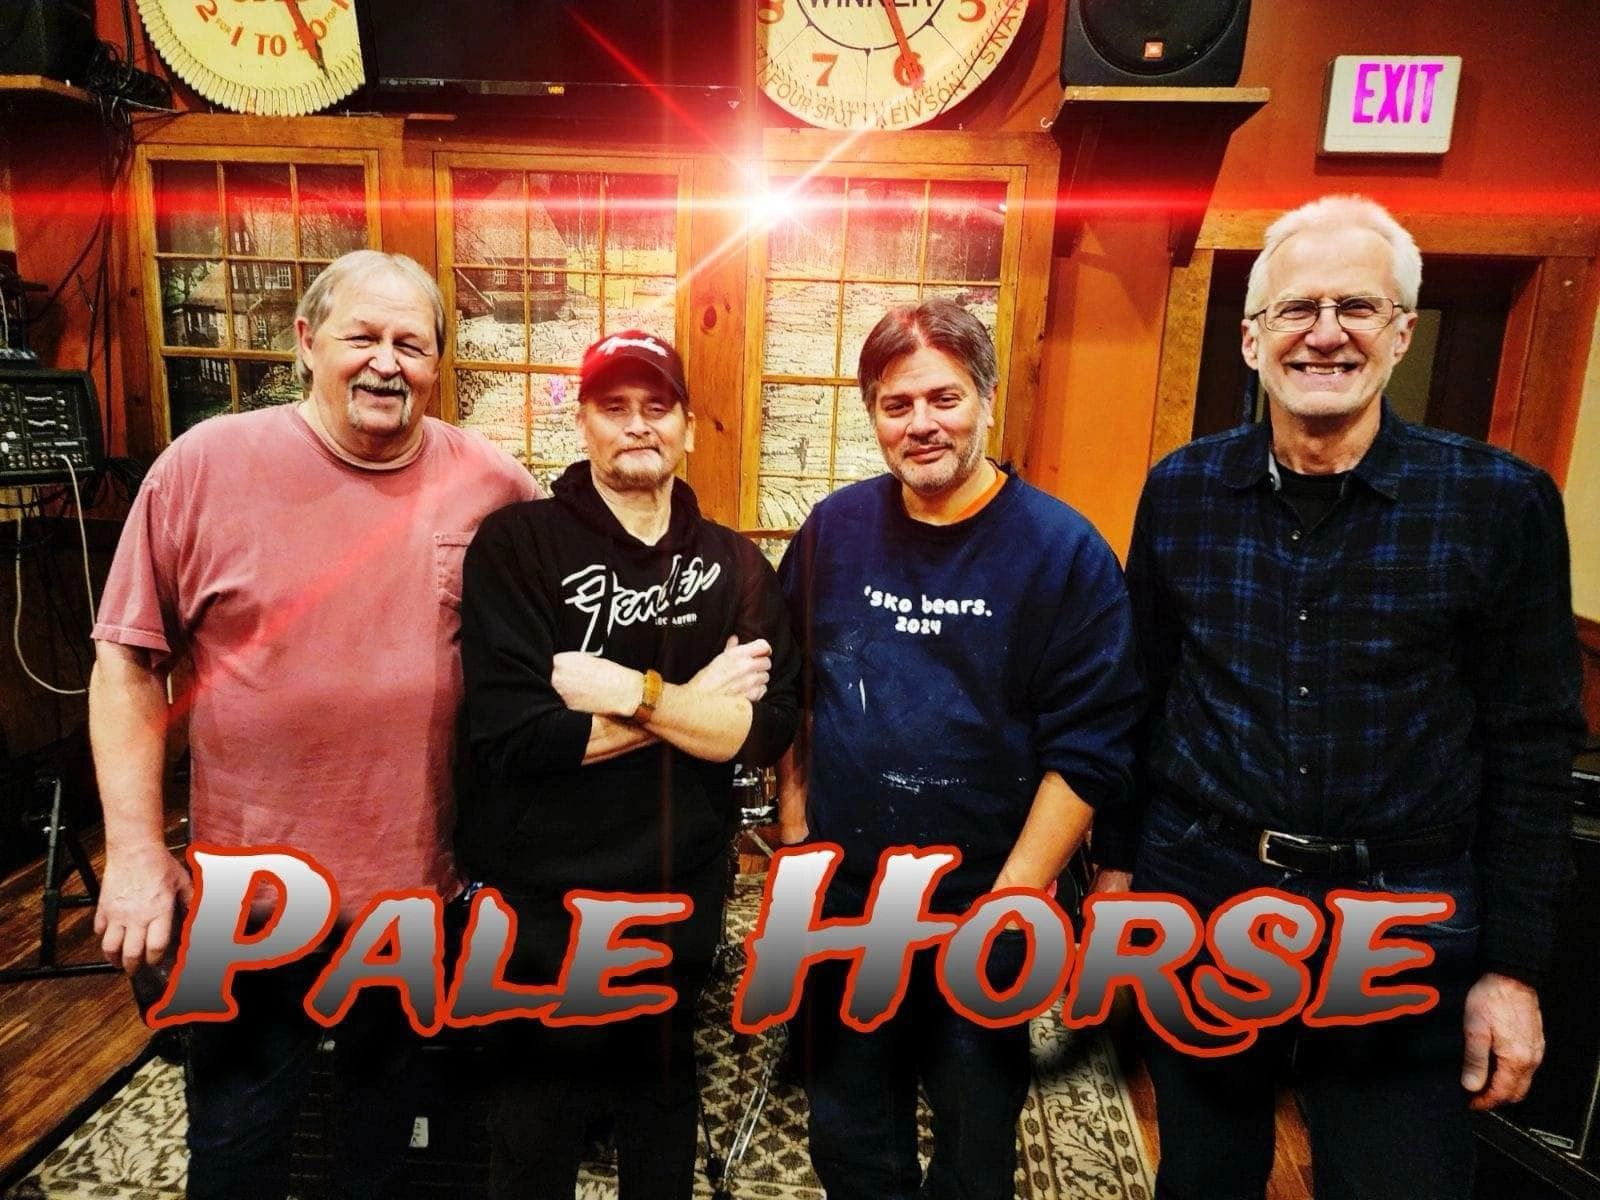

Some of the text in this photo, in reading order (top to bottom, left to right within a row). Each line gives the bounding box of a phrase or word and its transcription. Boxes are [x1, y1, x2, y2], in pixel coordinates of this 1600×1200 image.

[254, 33, 287, 57] TO
[811, 52, 839, 87] 7
[1352, 63, 1444, 124] EXIT
[921, 594, 993, 618] bears.
[894, 615, 942, 635] 2024
